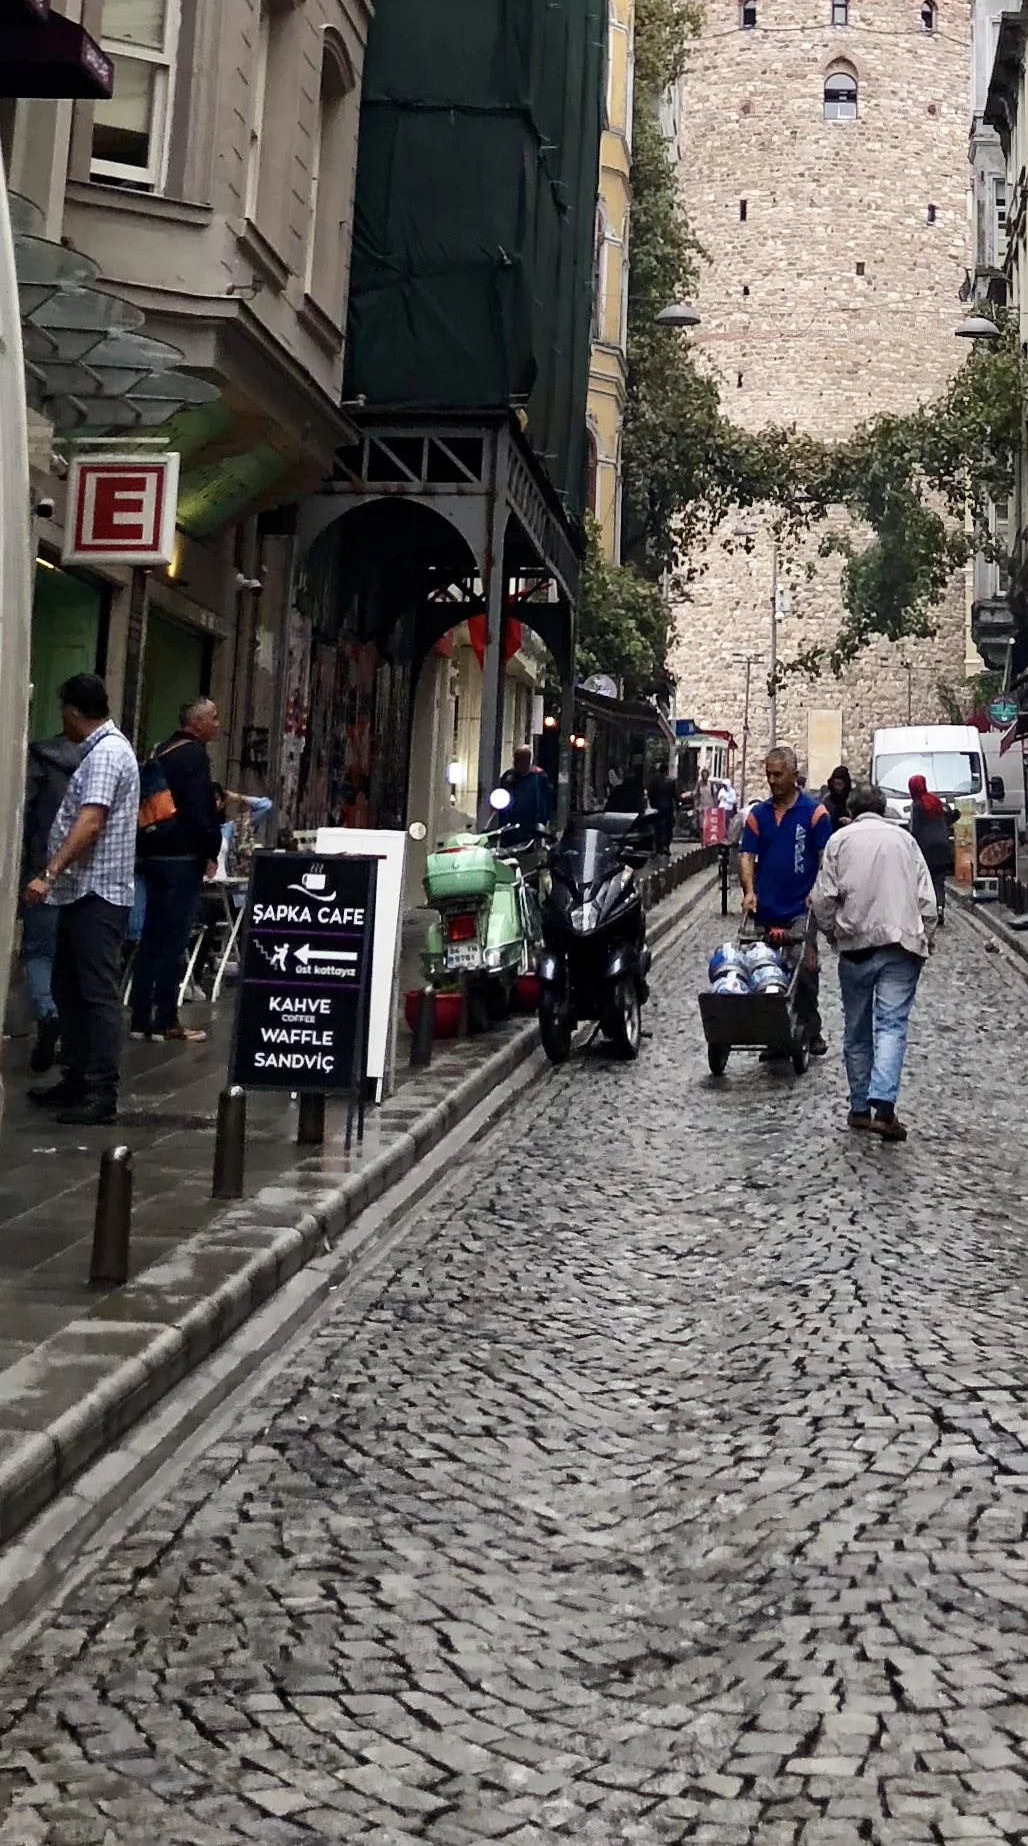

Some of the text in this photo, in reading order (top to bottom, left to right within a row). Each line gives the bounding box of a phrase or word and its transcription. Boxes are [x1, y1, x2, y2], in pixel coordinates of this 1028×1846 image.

[92, 477, 147, 540] E
[253, 904, 365, 925] ŞAPKA CAFE
[269, 997, 331, 1014] KAHVE
[260, 1028, 334, 1046] WAFFLE
[254, 1052, 335, 1073] SANDVİÇ
